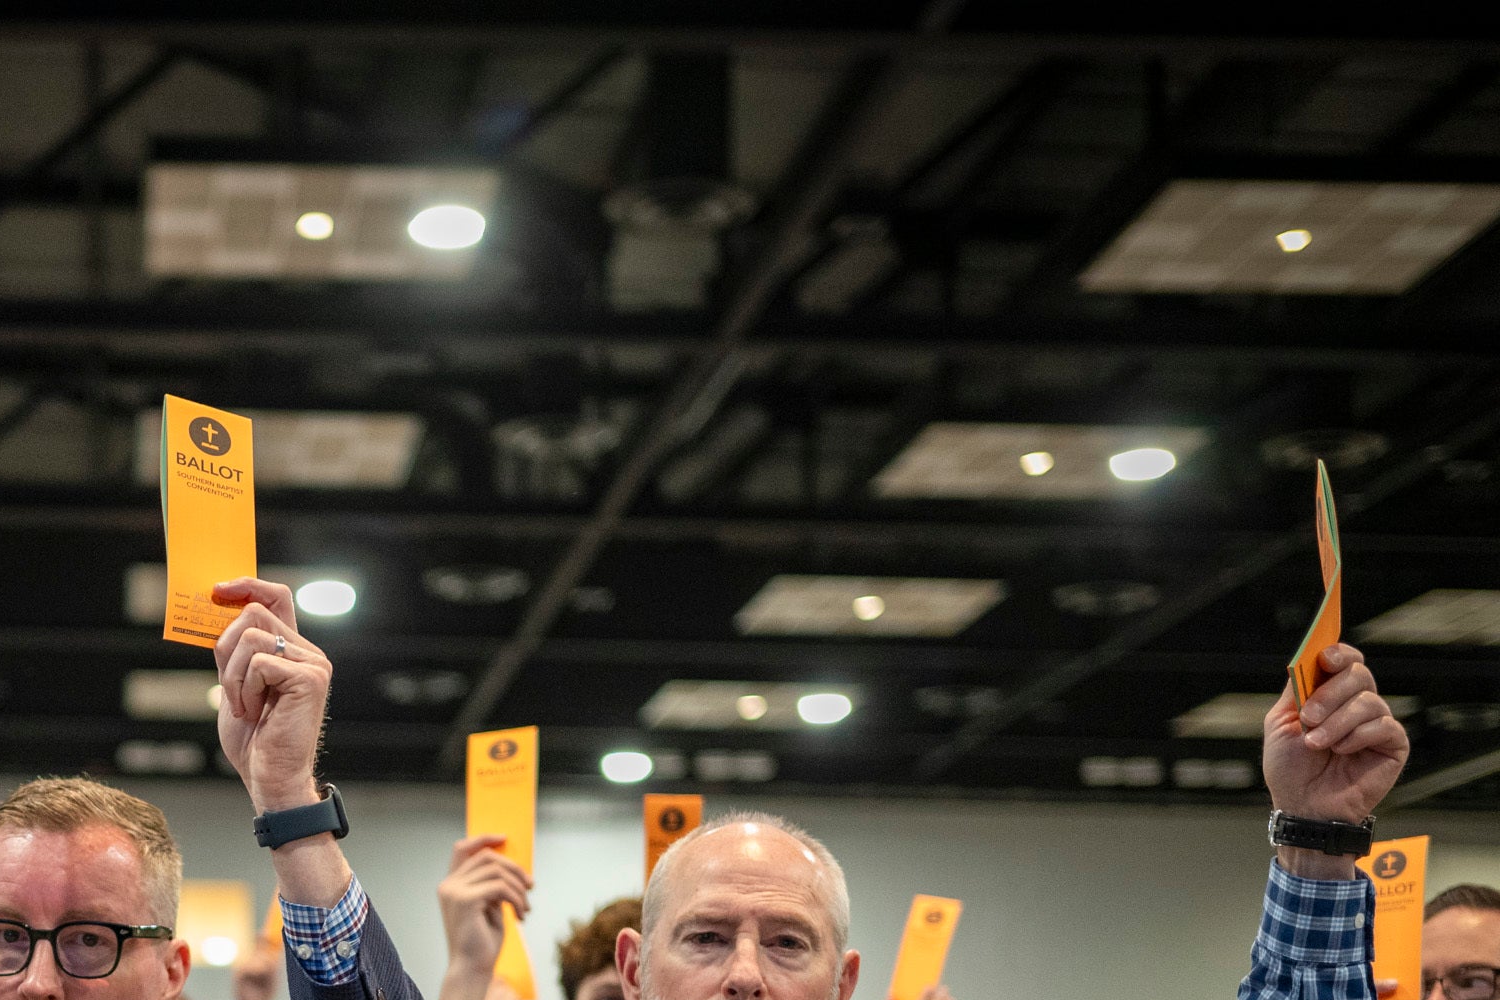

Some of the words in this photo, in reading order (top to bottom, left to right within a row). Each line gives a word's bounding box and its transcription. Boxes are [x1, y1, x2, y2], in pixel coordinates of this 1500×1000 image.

[176, 451, 244, 483] BALLOT
[177, 471, 215, 487] SOUTHERN
[216, 483, 244, 495] BAPTIST
[186, 481, 235, 500] CONVENTION
